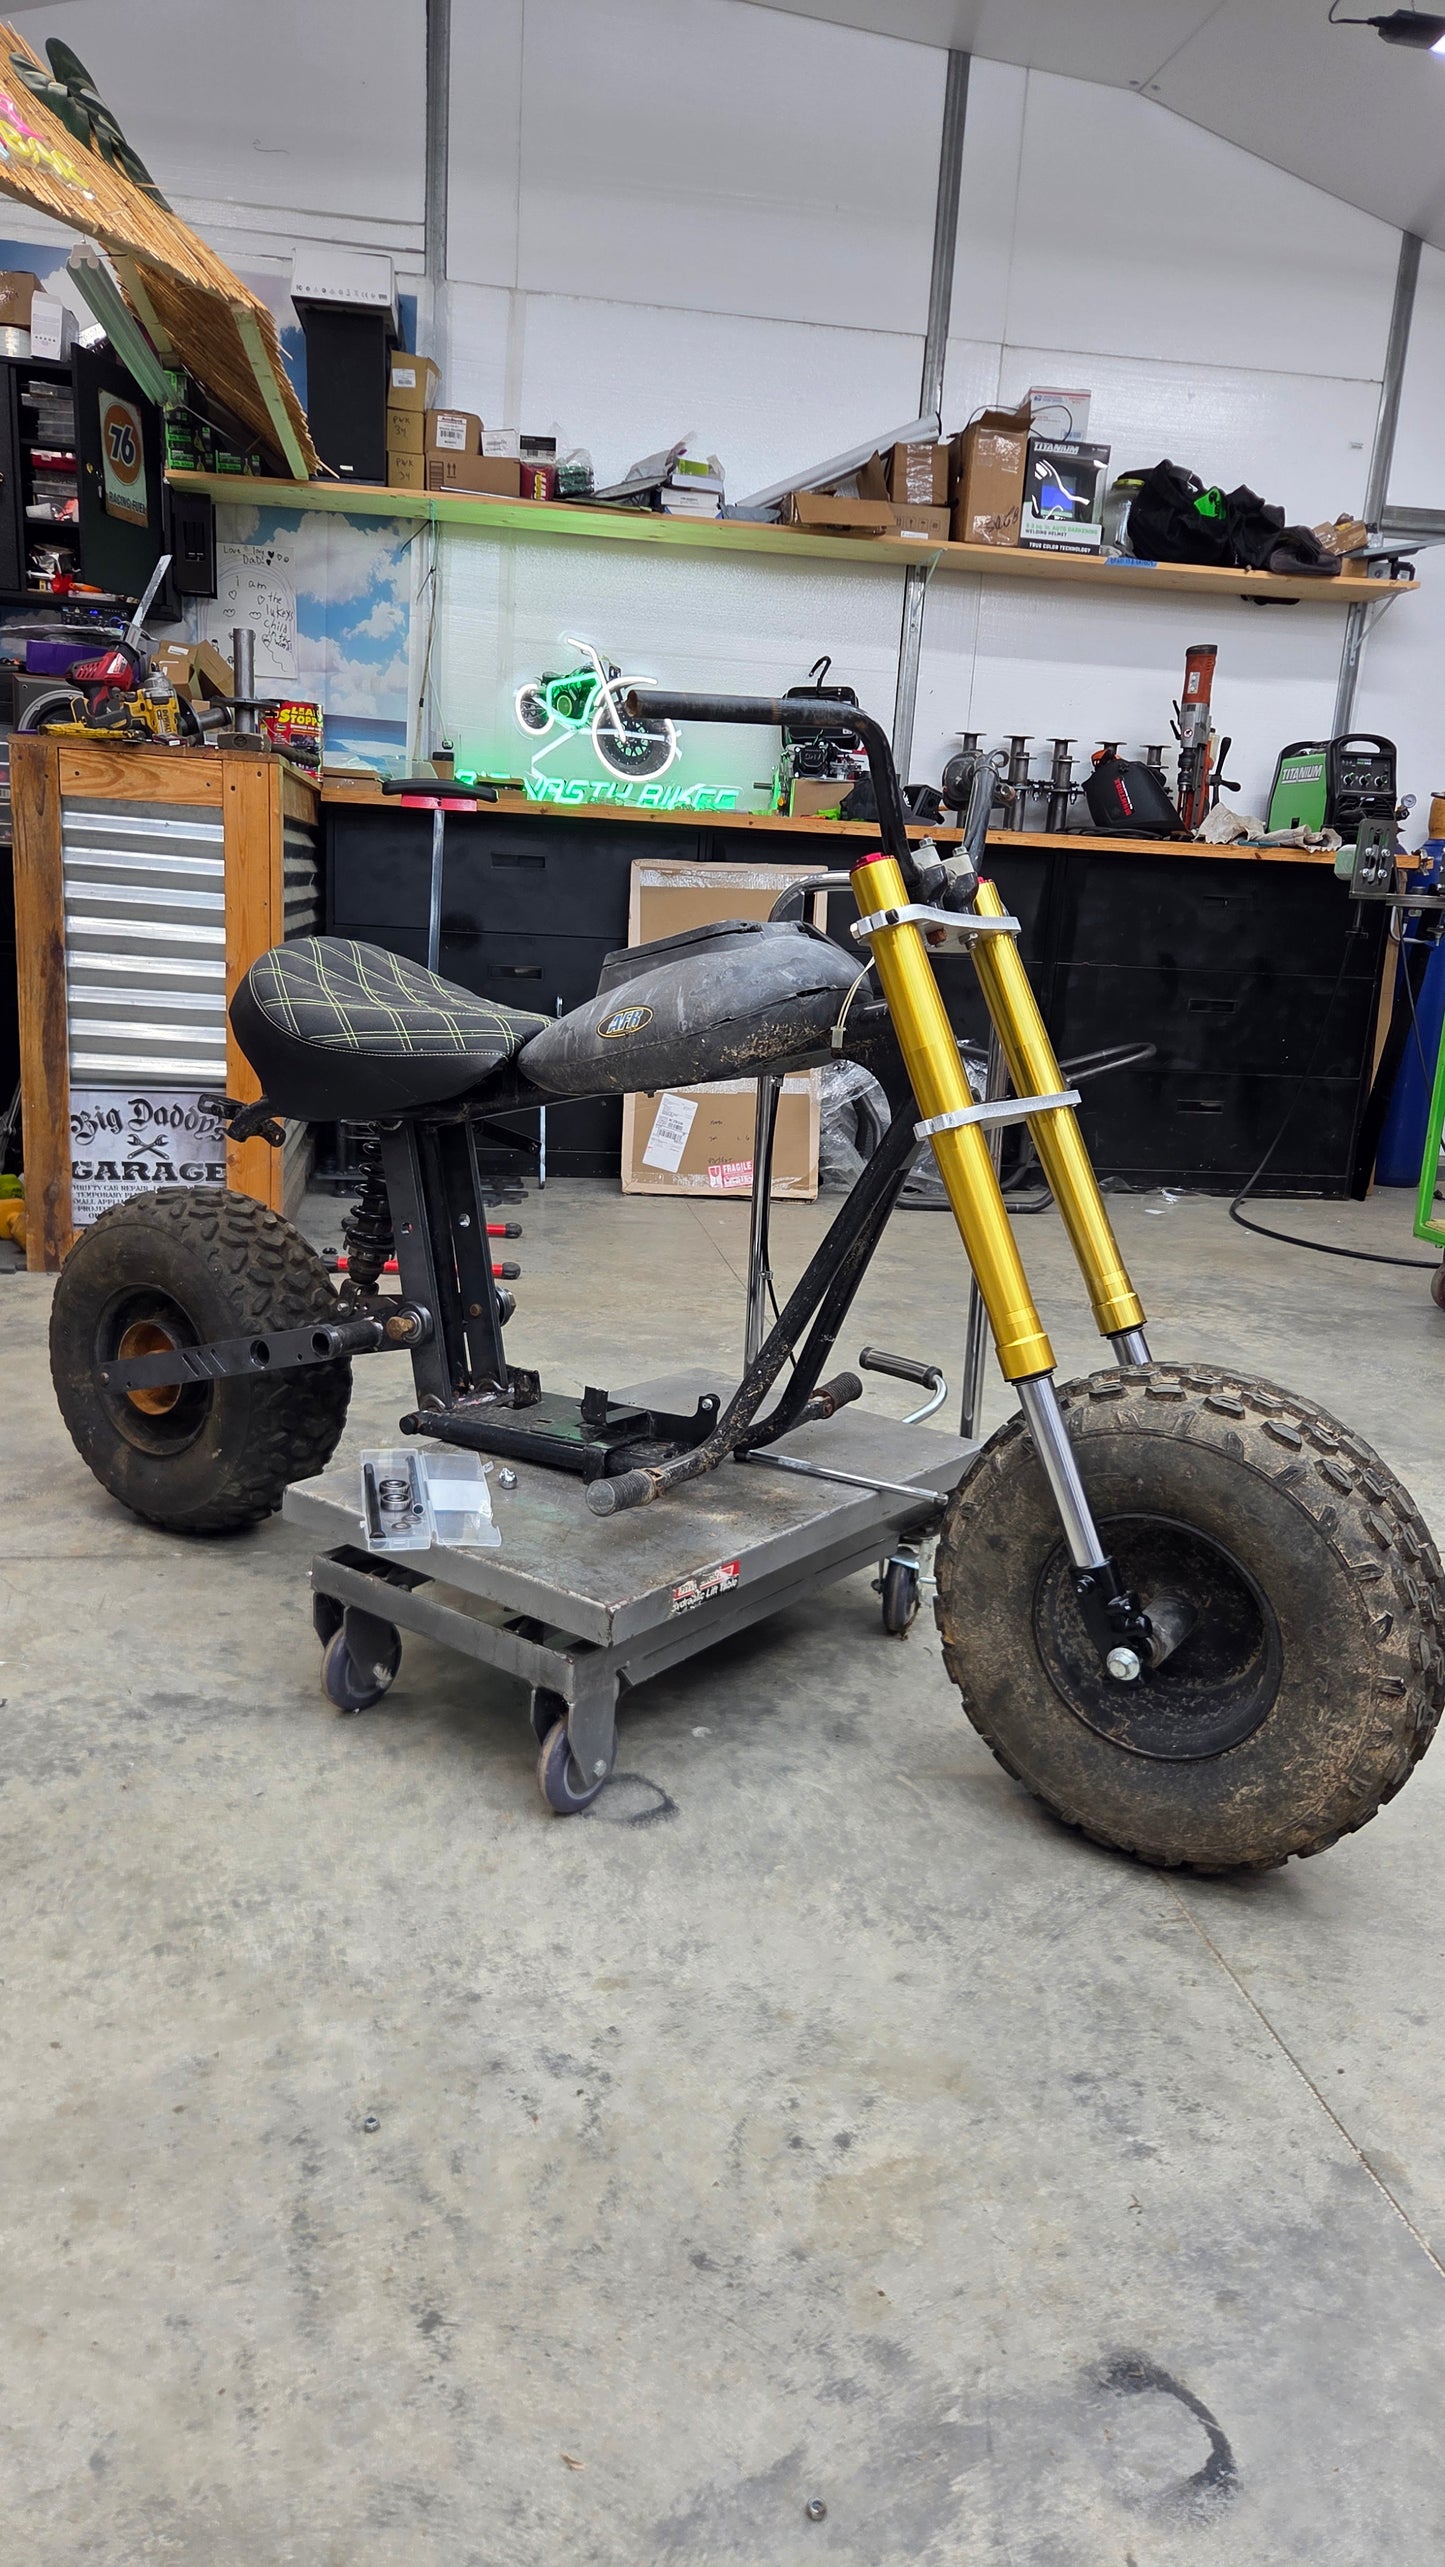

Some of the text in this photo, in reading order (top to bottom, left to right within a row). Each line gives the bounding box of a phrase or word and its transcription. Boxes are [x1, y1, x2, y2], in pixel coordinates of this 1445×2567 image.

[109, 423, 136, 468] 76
[1034, 442, 1079, 454] TITANIUM
[109, 490, 131, 509] RACING
[1025, 528, 1047, 536] WELDING
[1052, 524, 1067, 532] AUTO
[1067, 526, 1098, 535] DARKENING
[1029, 541, 1091, 553] TRUE COLOR TECHNOLOGY
[248, 580, 267, 590] am
[268, 593, 281, 604] the
[1282, 765, 1322, 780] TITANIUM
[70, 1105, 123, 1146] Big
[72, 1160, 227, 1182] GARAGE
[723, 1161, 752, 1173] FRAGILE
[705, 1585, 718, 1598] Lift
[720, 1577, 739, 1592] Table
